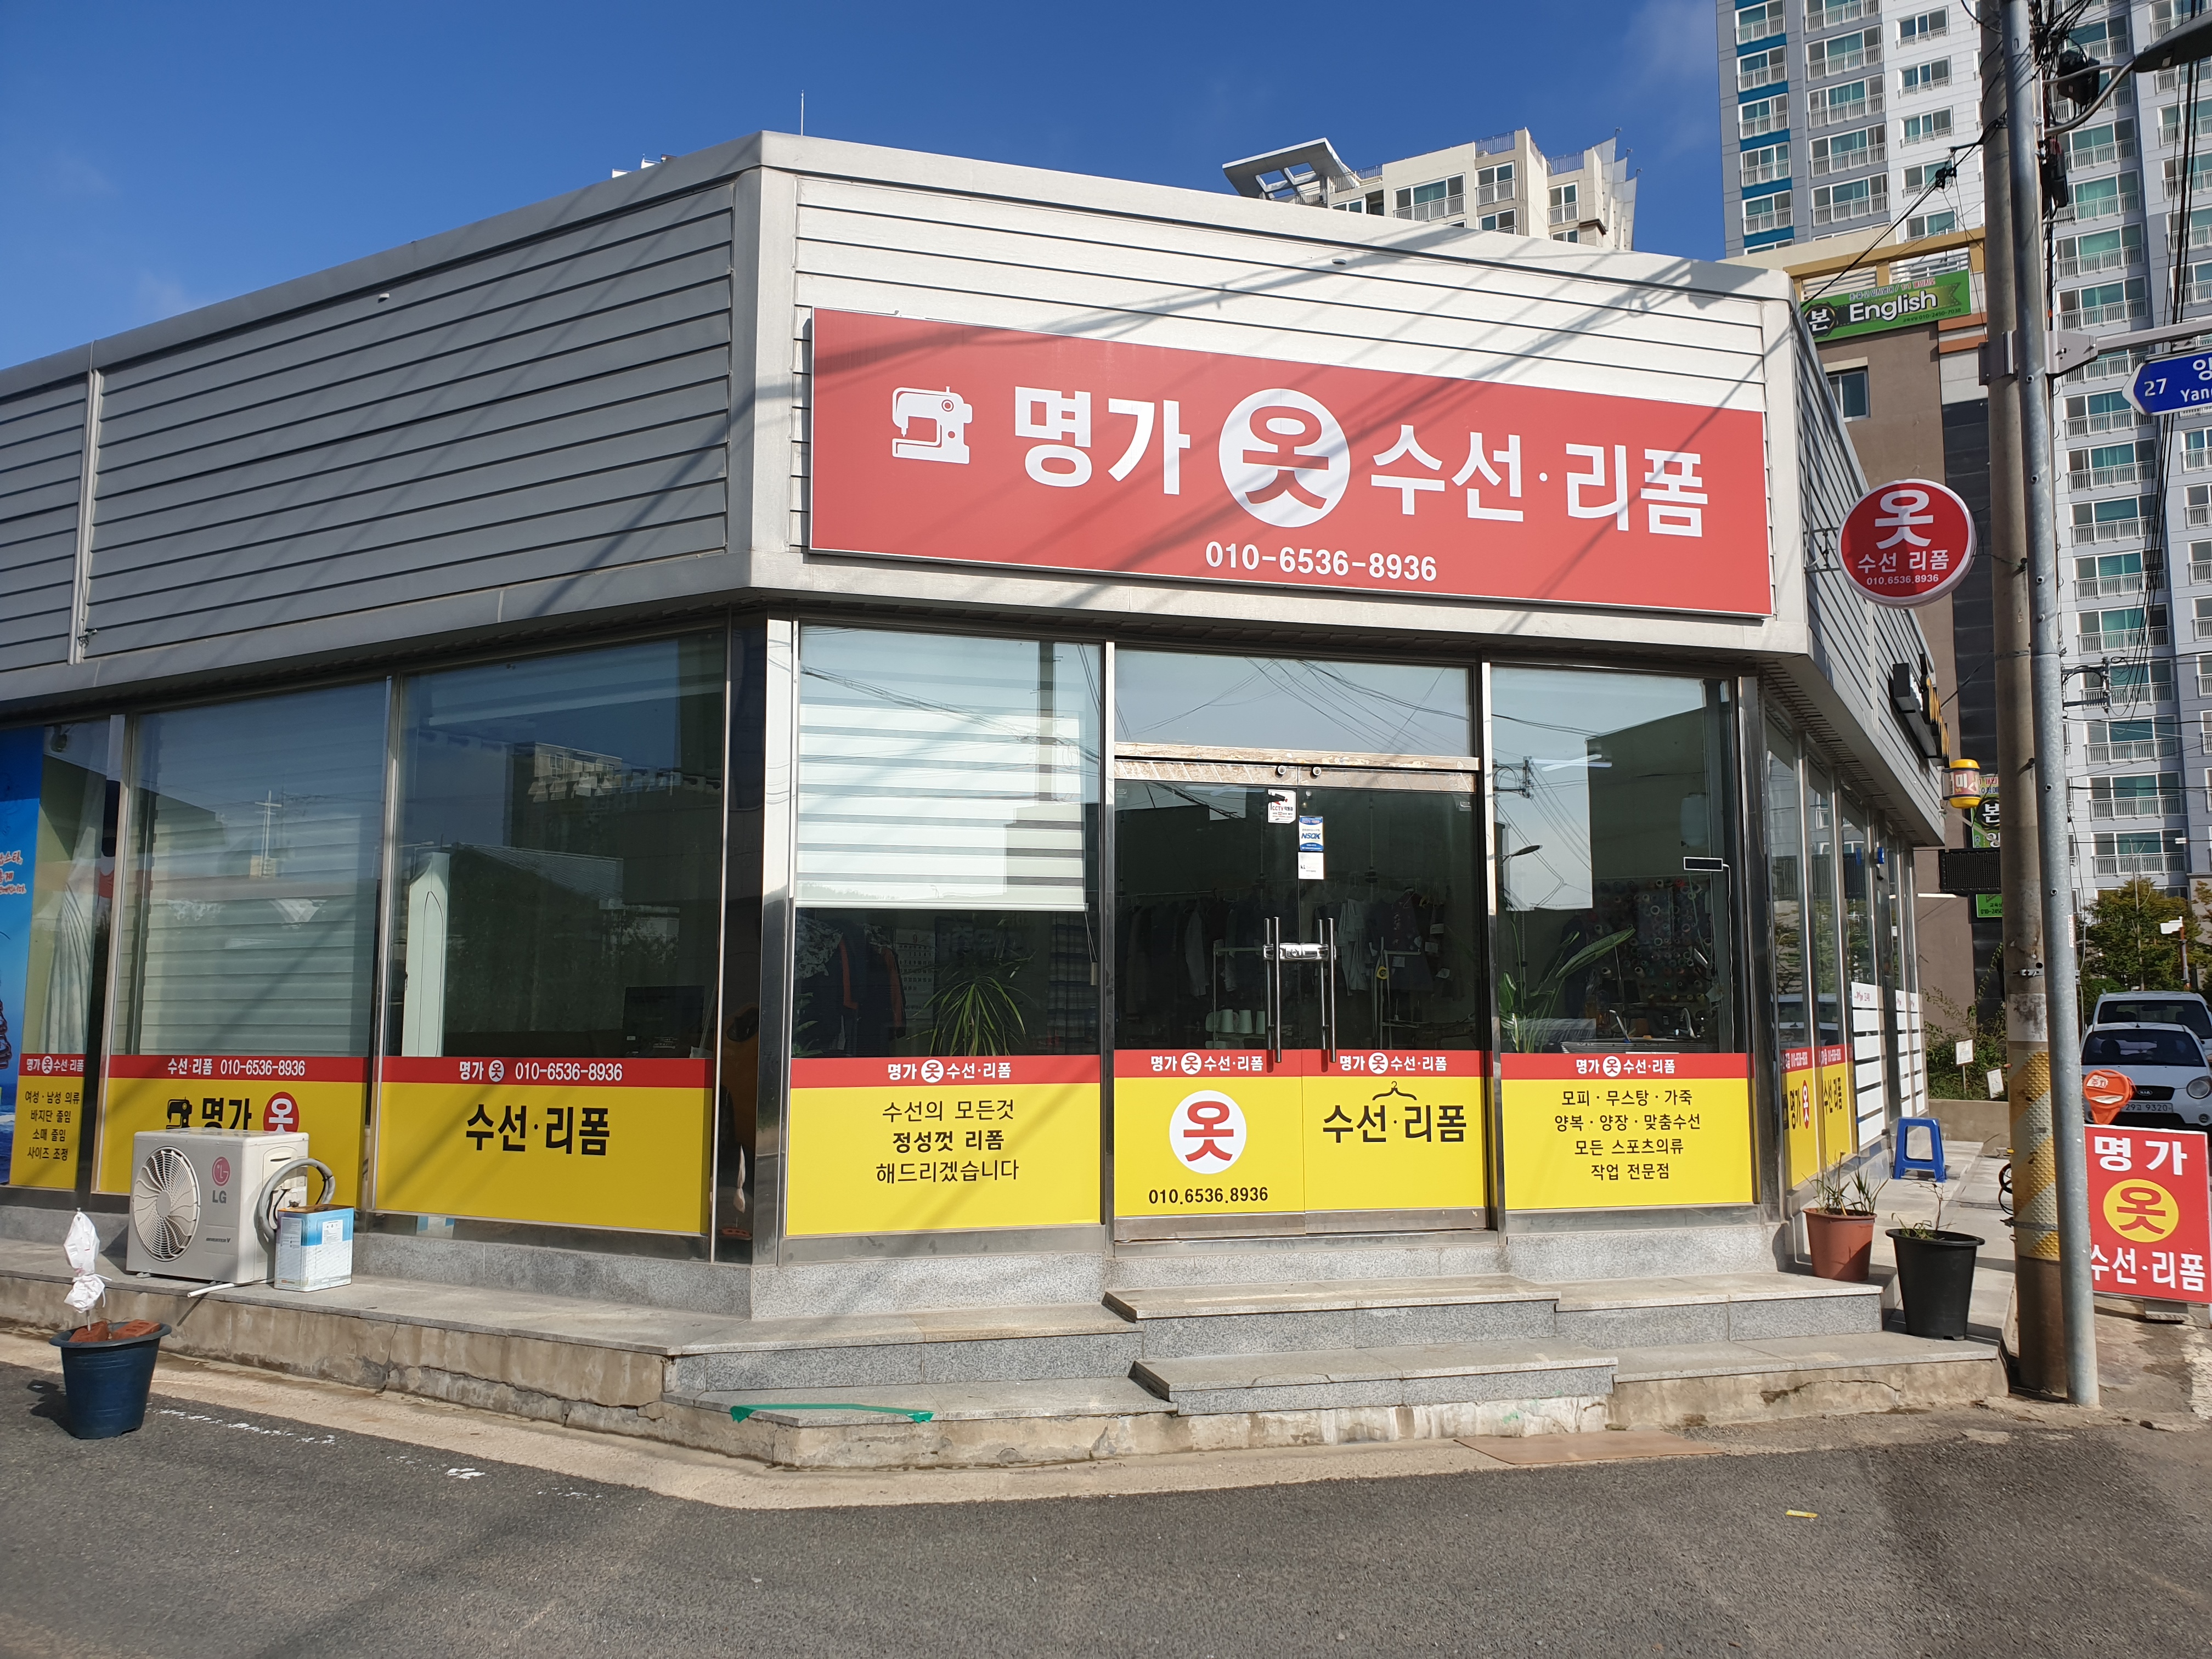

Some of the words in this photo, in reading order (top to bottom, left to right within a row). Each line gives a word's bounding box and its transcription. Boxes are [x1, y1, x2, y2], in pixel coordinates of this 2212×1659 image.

[1809, 309, 1830, 331] 본
[1849, 290, 1936, 321] English
[2144, 378, 2166, 396] 27
[2180, 388, 2212, 402] Yan
[1015, 386, 1190, 495] 명가
[1875, 490, 1933, 549] 옷
[1206, 541, 1436, 581] 010-6536-8936
[1858, 553, 1896, 573] 수선
[1910, 550, 1949, 570] 리폼
[1867, 574, 1939, 585] 010.6536.8936
[27, 1059, 40, 1071] 명가
[221, 1059, 305, 1076] 010-6536-8936
[460, 1062, 483, 1080] 명가
[516, 1063, 622, 1081] 010-6536-8936
[1152, 1056, 1177, 1071] 명가
[1340, 1056, 1365, 1070] 명가
[1576, 1059, 1599, 1074] 명가
[888, 1064, 917, 1080] 명가
[25, 1091, 39, 1103] 여성
[47, 1092, 61, 1104] 남성
[65, 1092, 80, 1104] 의류
[1562, 1091, 1589, 1106] 모피
[1606, 1090, 1649, 1106] 무스탕
[1665, 1090, 1692, 1105] 가죽
[31, 1110, 53, 1122] 바지단
[57, 1110, 71, 1123] 줄임
[202, 1098, 251, 1129] 명가
[883, 1101, 942, 1122] 수선의
[955, 1099, 1013, 1120] 모든것
[1790, 1088, 1801, 1129] 명가
[1555, 1115, 1583, 1132] 양복
[1600, 1115, 1628, 1131] 양장
[1645, 1114, 1700, 1130] 맞춤수선
[52, 1129, 65, 1142] 줄임
[893, 1131, 953, 1153] 정성껏
[966, 1130, 1004, 1150] 리폼
[27, 1147, 49, 1159] 사이즈
[53, 1148, 67, 1161] 조정
[1575, 1141, 1603, 1155] 모든
[1612, 1138, 1683, 1154] 스포츠의류
[876, 1160, 1019, 1183] 해드리겠습니다
[1592, 1164, 1618, 1180] 작업
[1628, 1163, 1668, 1180] 전문점
[212, 1190, 227, 1204] LG
[1149, 1187, 1268, 1204] 010.6536.8936
[2117, 1187, 2166, 1234] 옷
